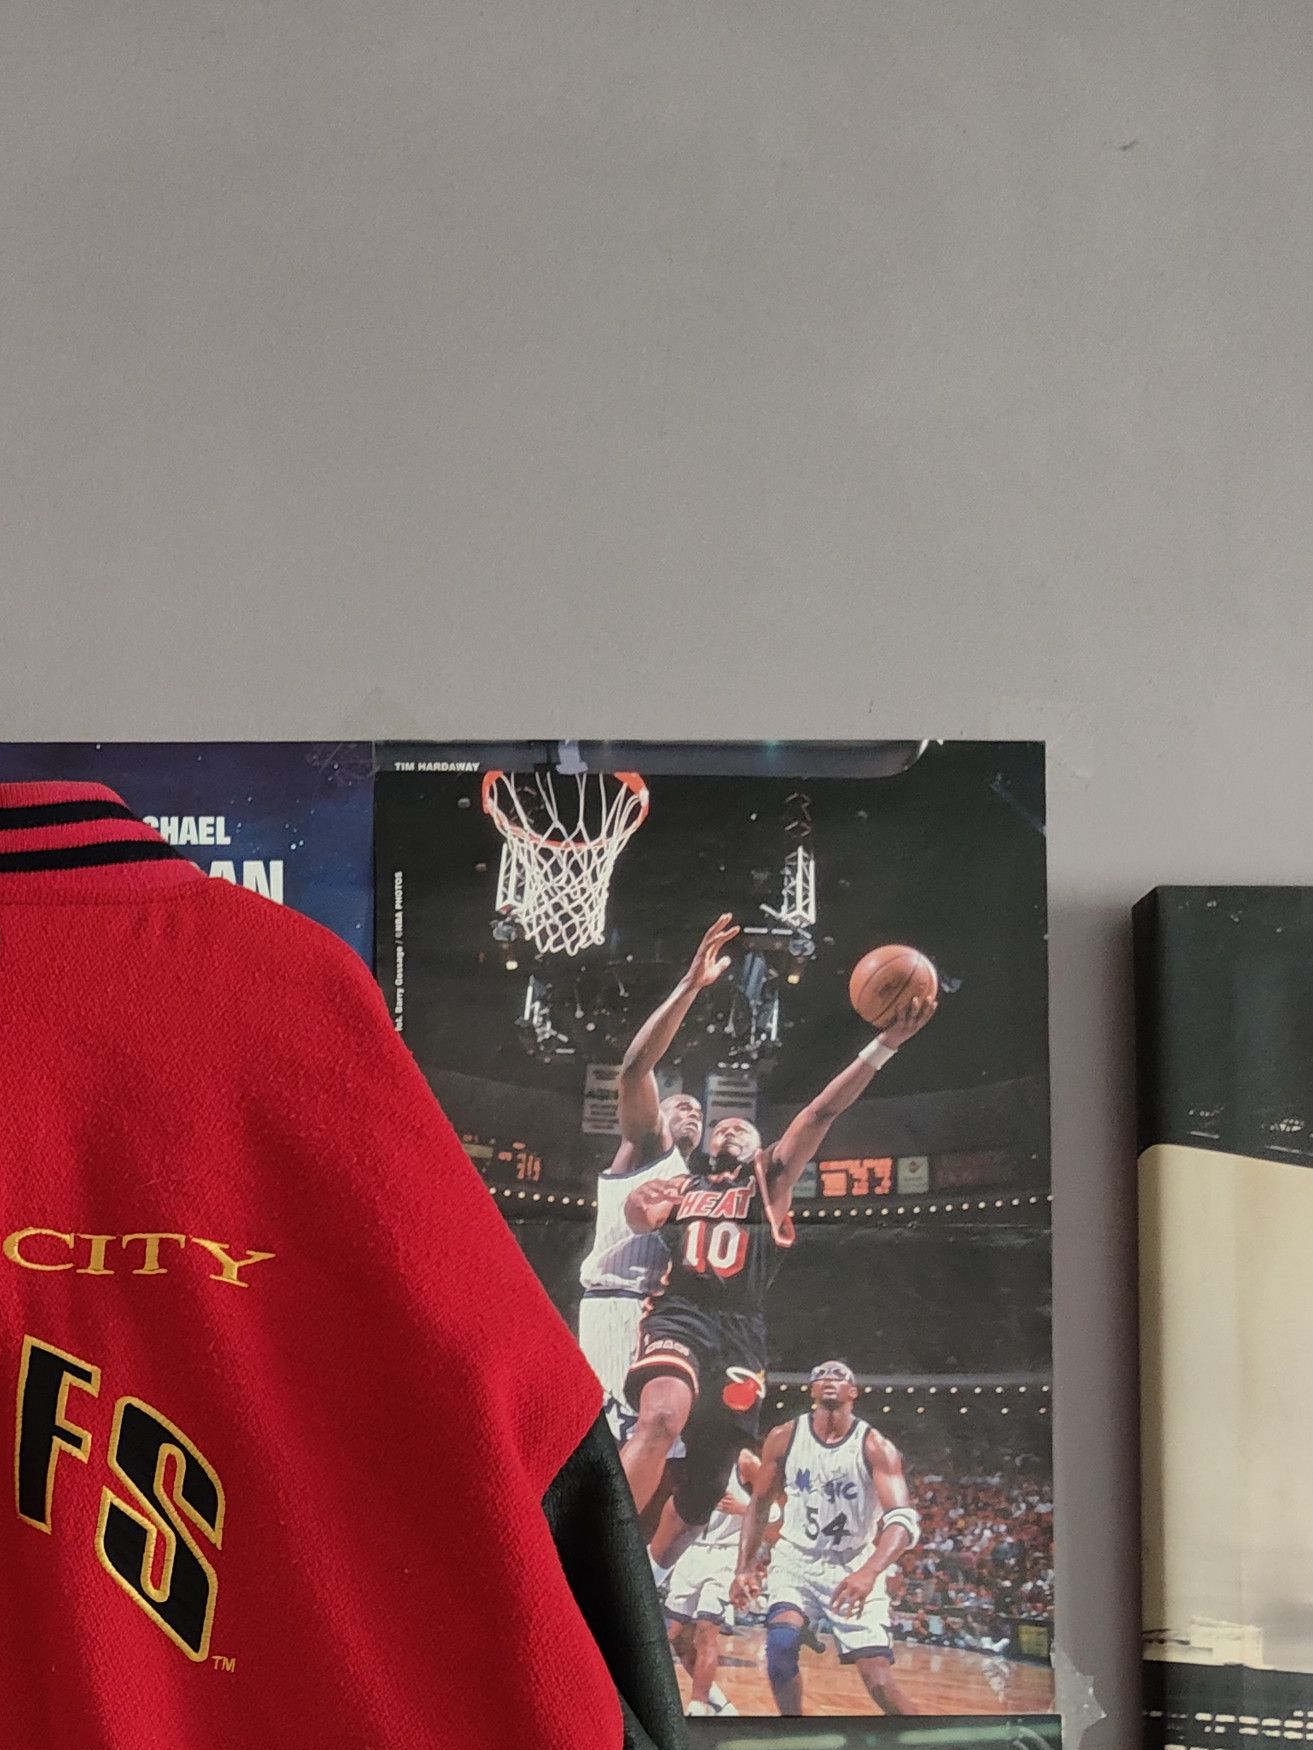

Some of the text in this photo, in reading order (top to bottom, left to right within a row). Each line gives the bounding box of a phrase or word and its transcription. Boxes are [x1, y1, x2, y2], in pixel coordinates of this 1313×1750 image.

[394, 762, 480, 771] TIM HARDAWAY
[394, 871, 404, 910] PHOTOS
[676, 1175, 755, 1220] HEAT
[3, 1226, 276, 1288] CITY
[684, 1220, 749, 1278] 10
[801, 1506, 852, 1546] 54
